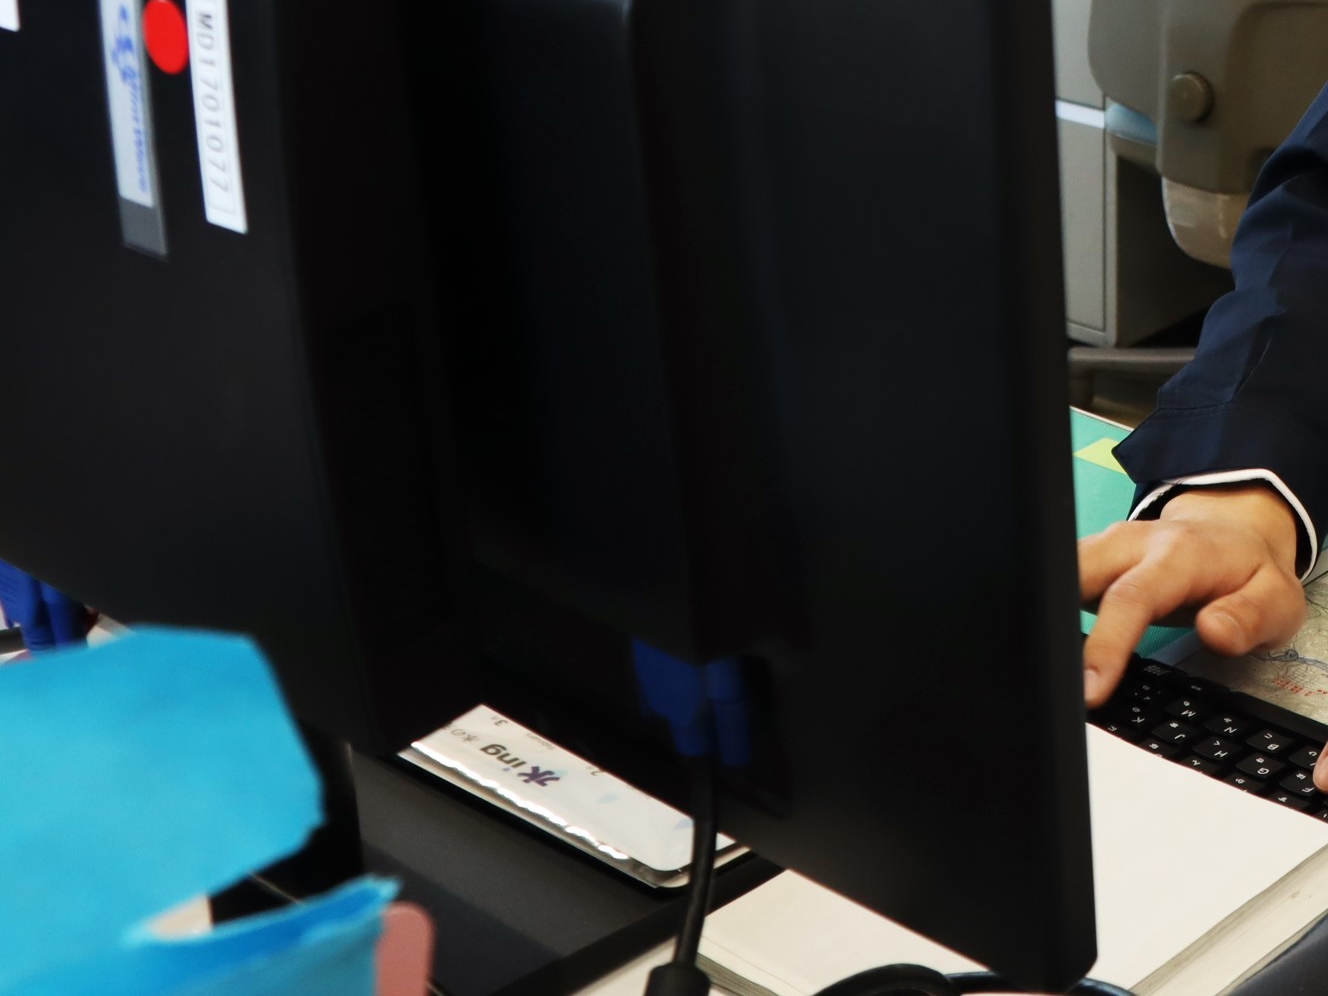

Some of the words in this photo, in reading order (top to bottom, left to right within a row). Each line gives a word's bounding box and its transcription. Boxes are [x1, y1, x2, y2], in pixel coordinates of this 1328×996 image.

[195, 10, 229, 193] MD1701077
[1181, 709, 1196, 717] M
[1224, 726, 1237, 734] N
[1267, 743, 1280, 751] B
[1214, 750, 1228, 758] H
